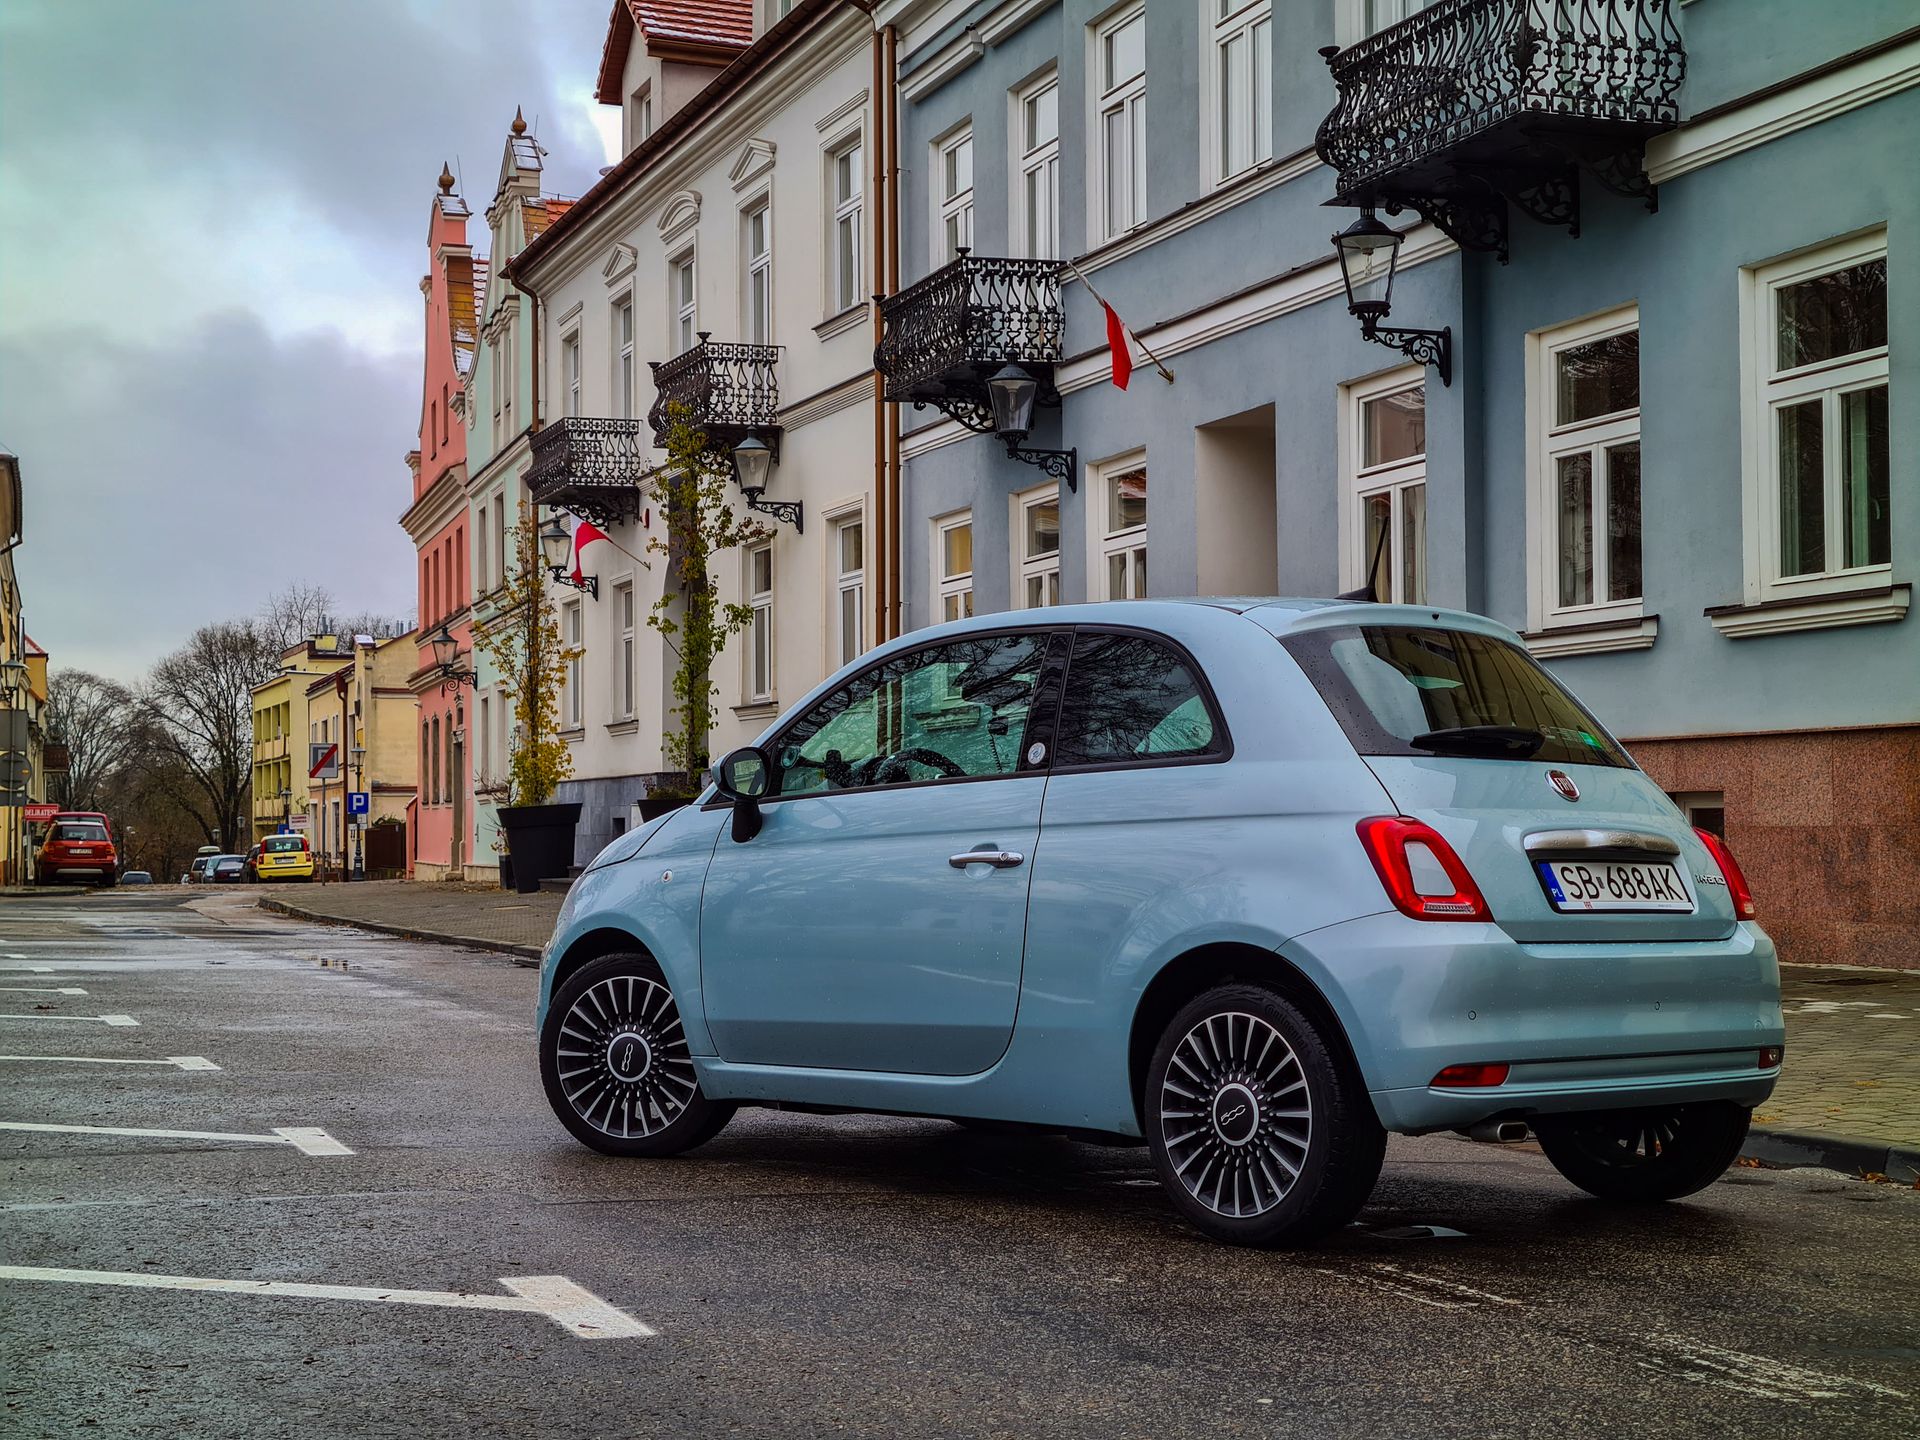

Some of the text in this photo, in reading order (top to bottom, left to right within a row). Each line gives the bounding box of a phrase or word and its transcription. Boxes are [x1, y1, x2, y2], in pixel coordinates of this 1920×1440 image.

[352, 794, 365, 811] P
[1560, 865, 1684, 901] SB 688AK
[1551, 887, 1563, 898] PL
